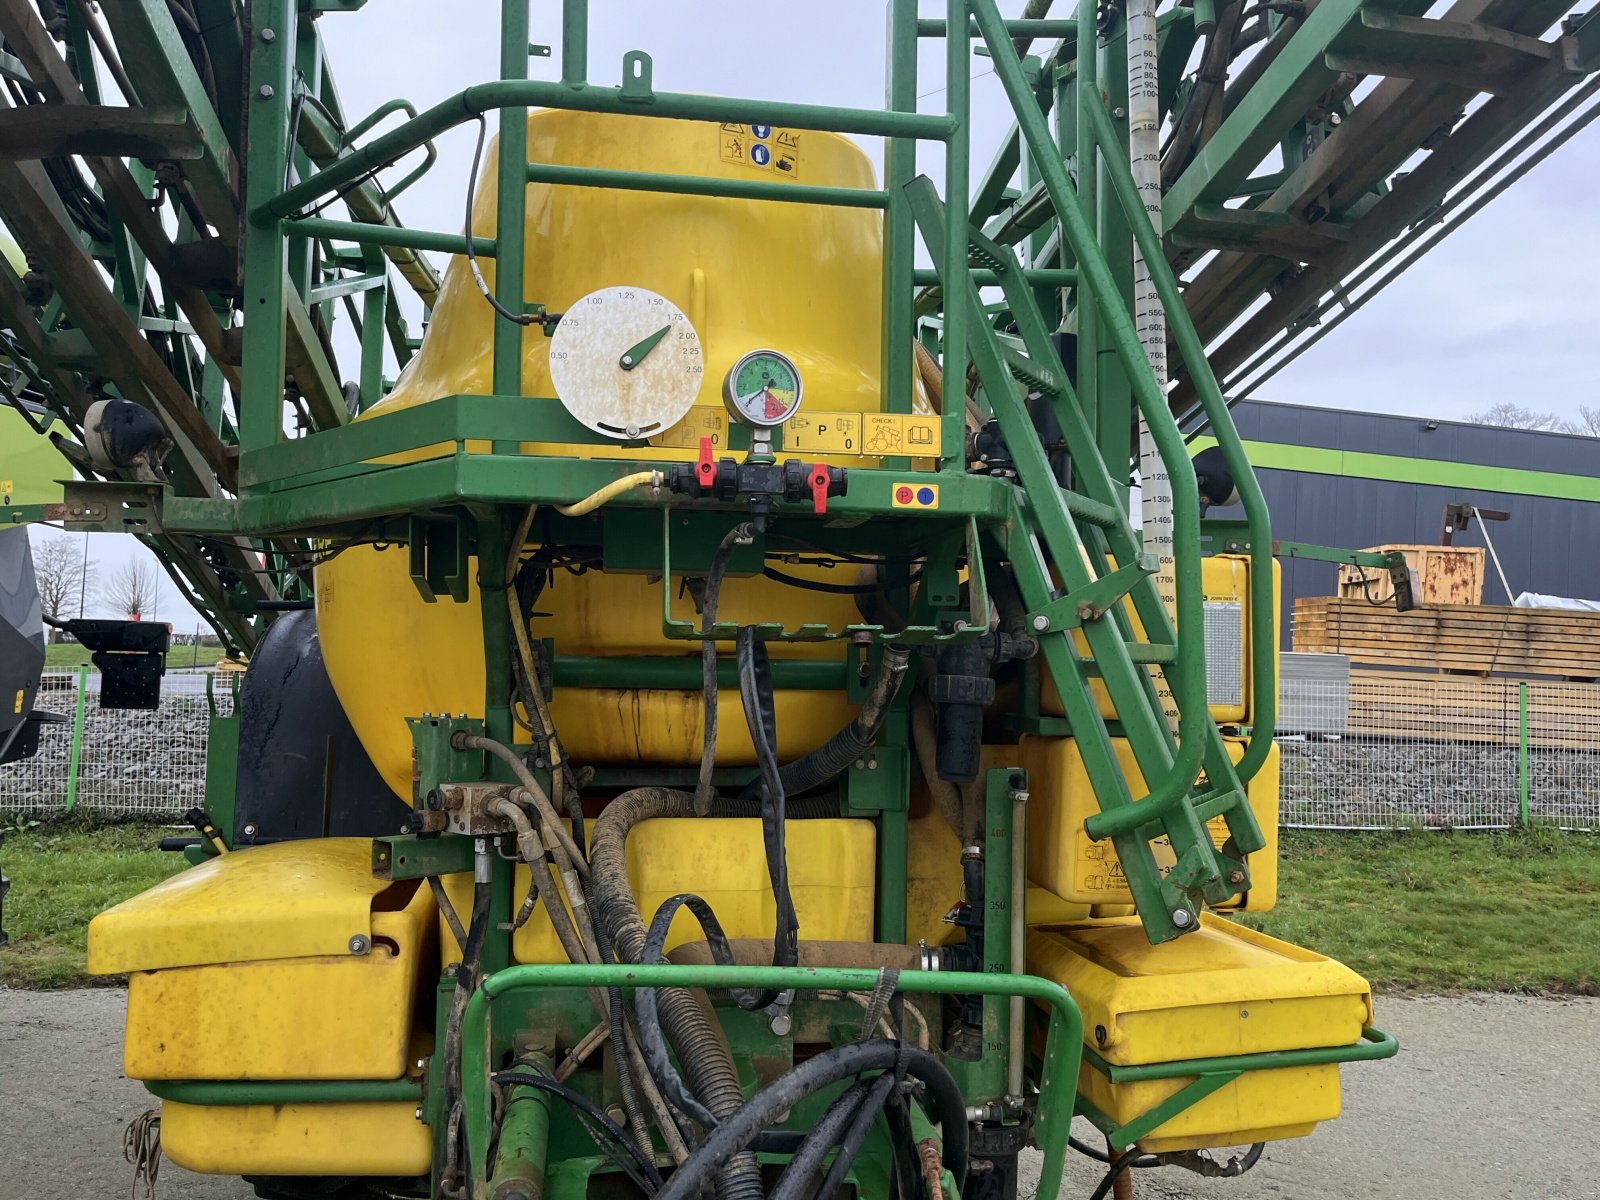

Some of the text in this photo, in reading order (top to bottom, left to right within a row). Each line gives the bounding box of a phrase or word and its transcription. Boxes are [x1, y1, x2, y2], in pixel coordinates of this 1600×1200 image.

[818, 425, 827, 435] P
[922, 492, 929, 500] T
[990, 901, 1006, 910] 350
[989, 964, 1004, 972] 250
[988, 1042, 1002, 1051] 150
